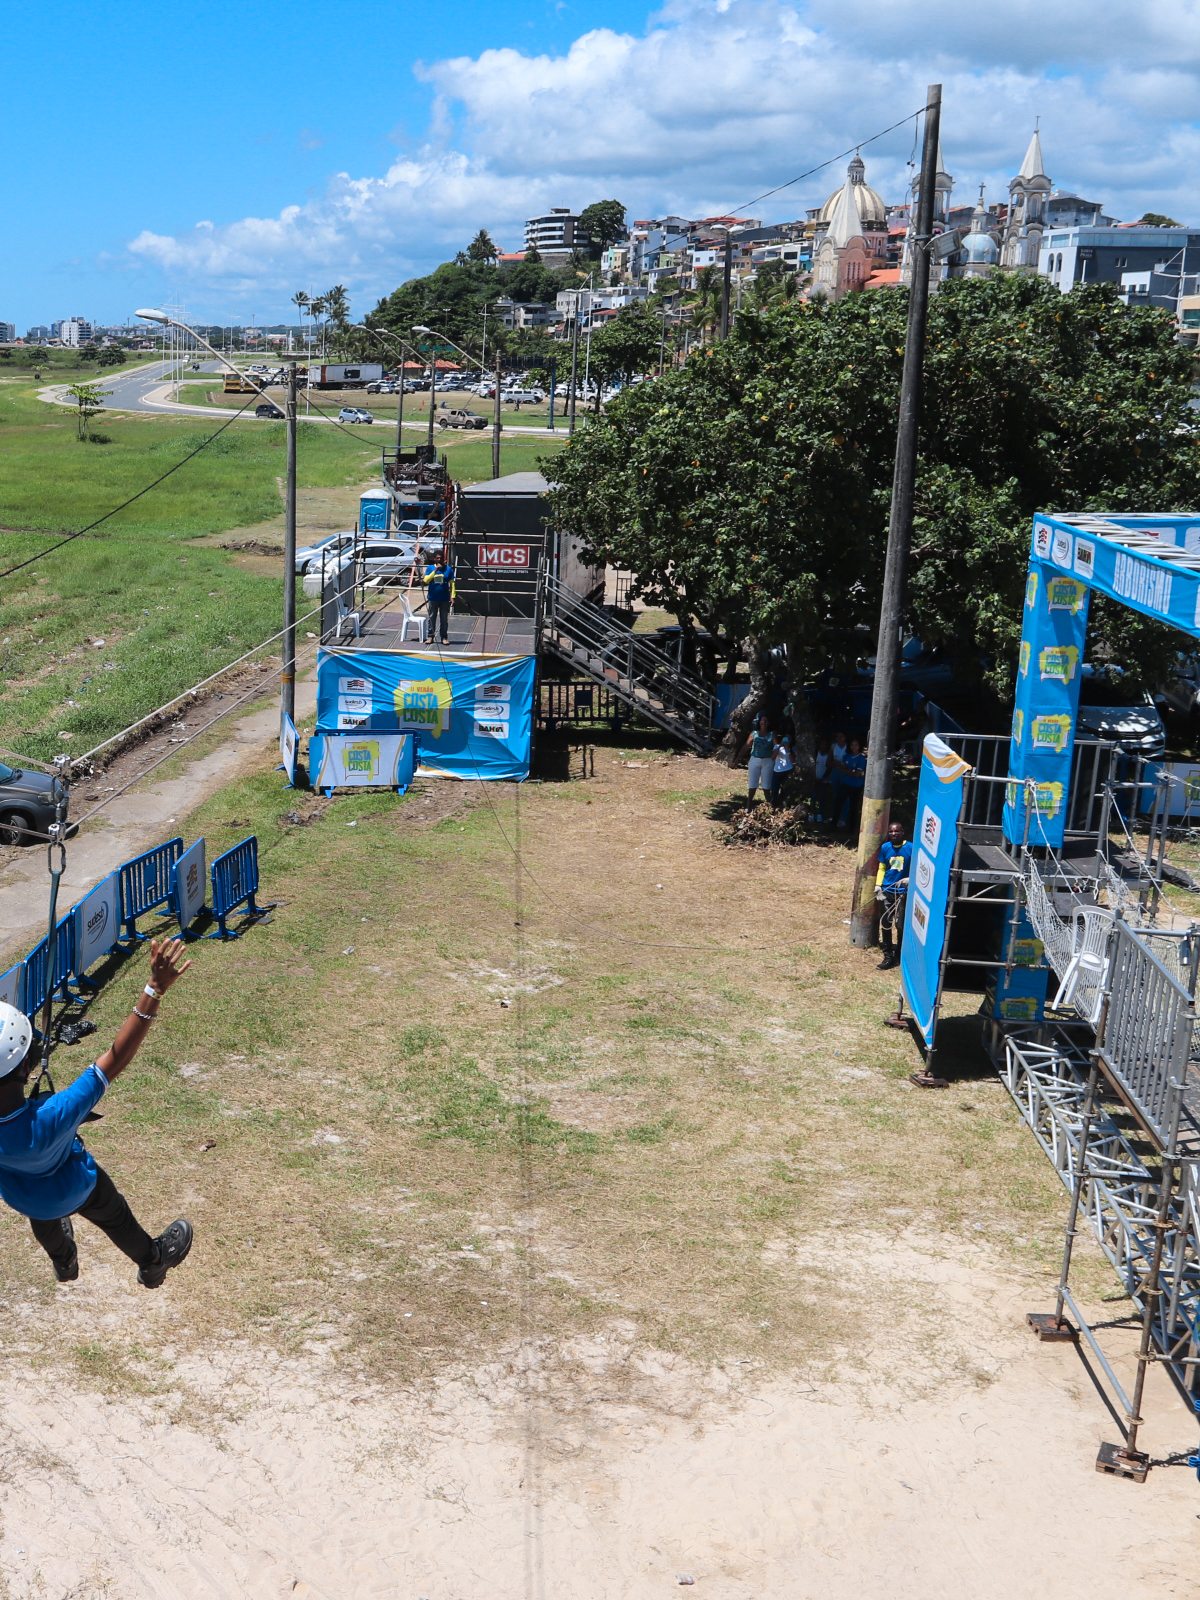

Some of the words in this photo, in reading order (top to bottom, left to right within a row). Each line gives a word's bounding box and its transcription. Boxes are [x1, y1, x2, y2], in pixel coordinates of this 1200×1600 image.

[482, 548, 527, 564] MCS
[1113, 552, 1173, 614] ARBORISMO
[1053, 584, 1077, 595] COSTA
[1052, 594, 1076, 605] COSTA
[1046, 654, 1070, 665] COSTA
[1045, 664, 1068, 675] COSTA
[403, 693, 439, 709] COSTA
[403, 708, 439, 724] COSTA
[1038, 723, 1062, 733] COSTA
[1037, 732, 1061, 743] COSTA
[348, 750, 371, 761] COSTA
[349, 760, 371, 771] COSTA
[87, 905, 105, 932] sudesb
